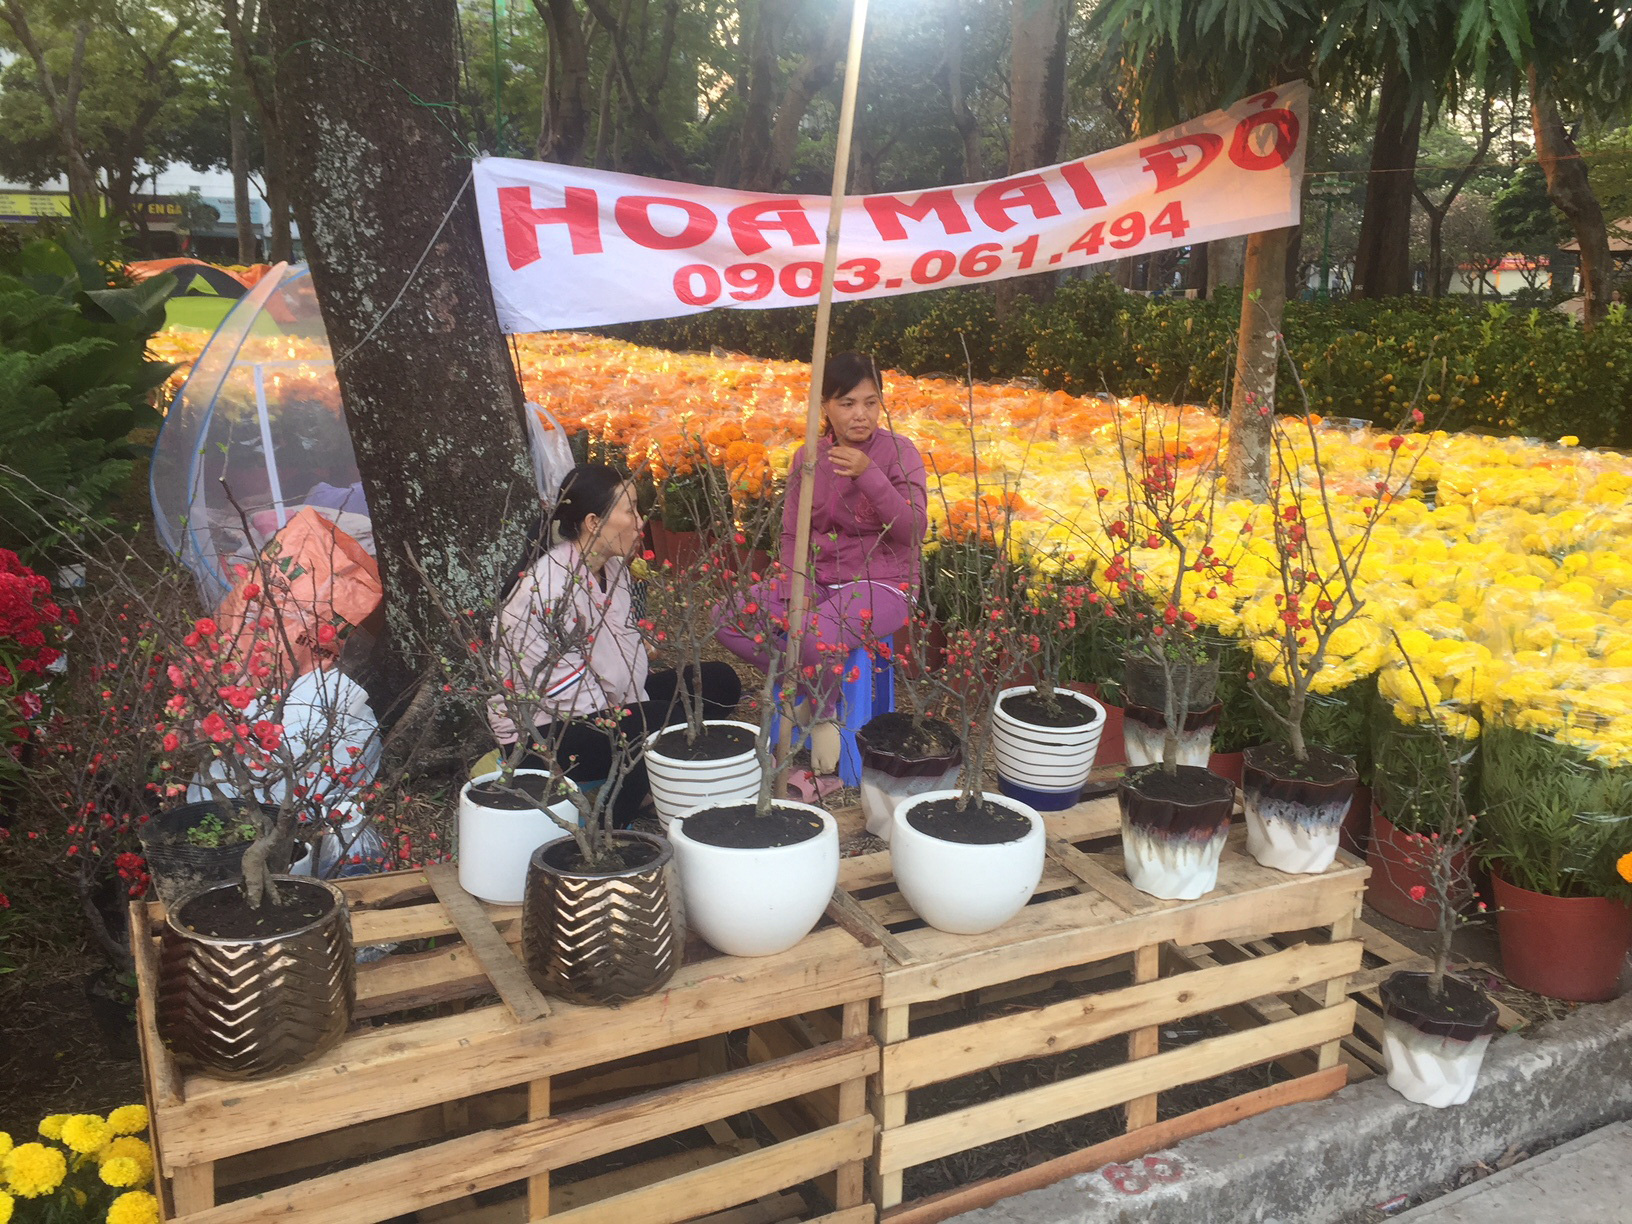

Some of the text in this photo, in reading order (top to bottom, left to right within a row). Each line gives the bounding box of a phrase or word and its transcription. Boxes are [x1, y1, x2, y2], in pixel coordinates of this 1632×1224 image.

[497, 91, 1300, 271] HOA MAI ĐỎ
[673, 201, 1190, 306] 0903.061.494
